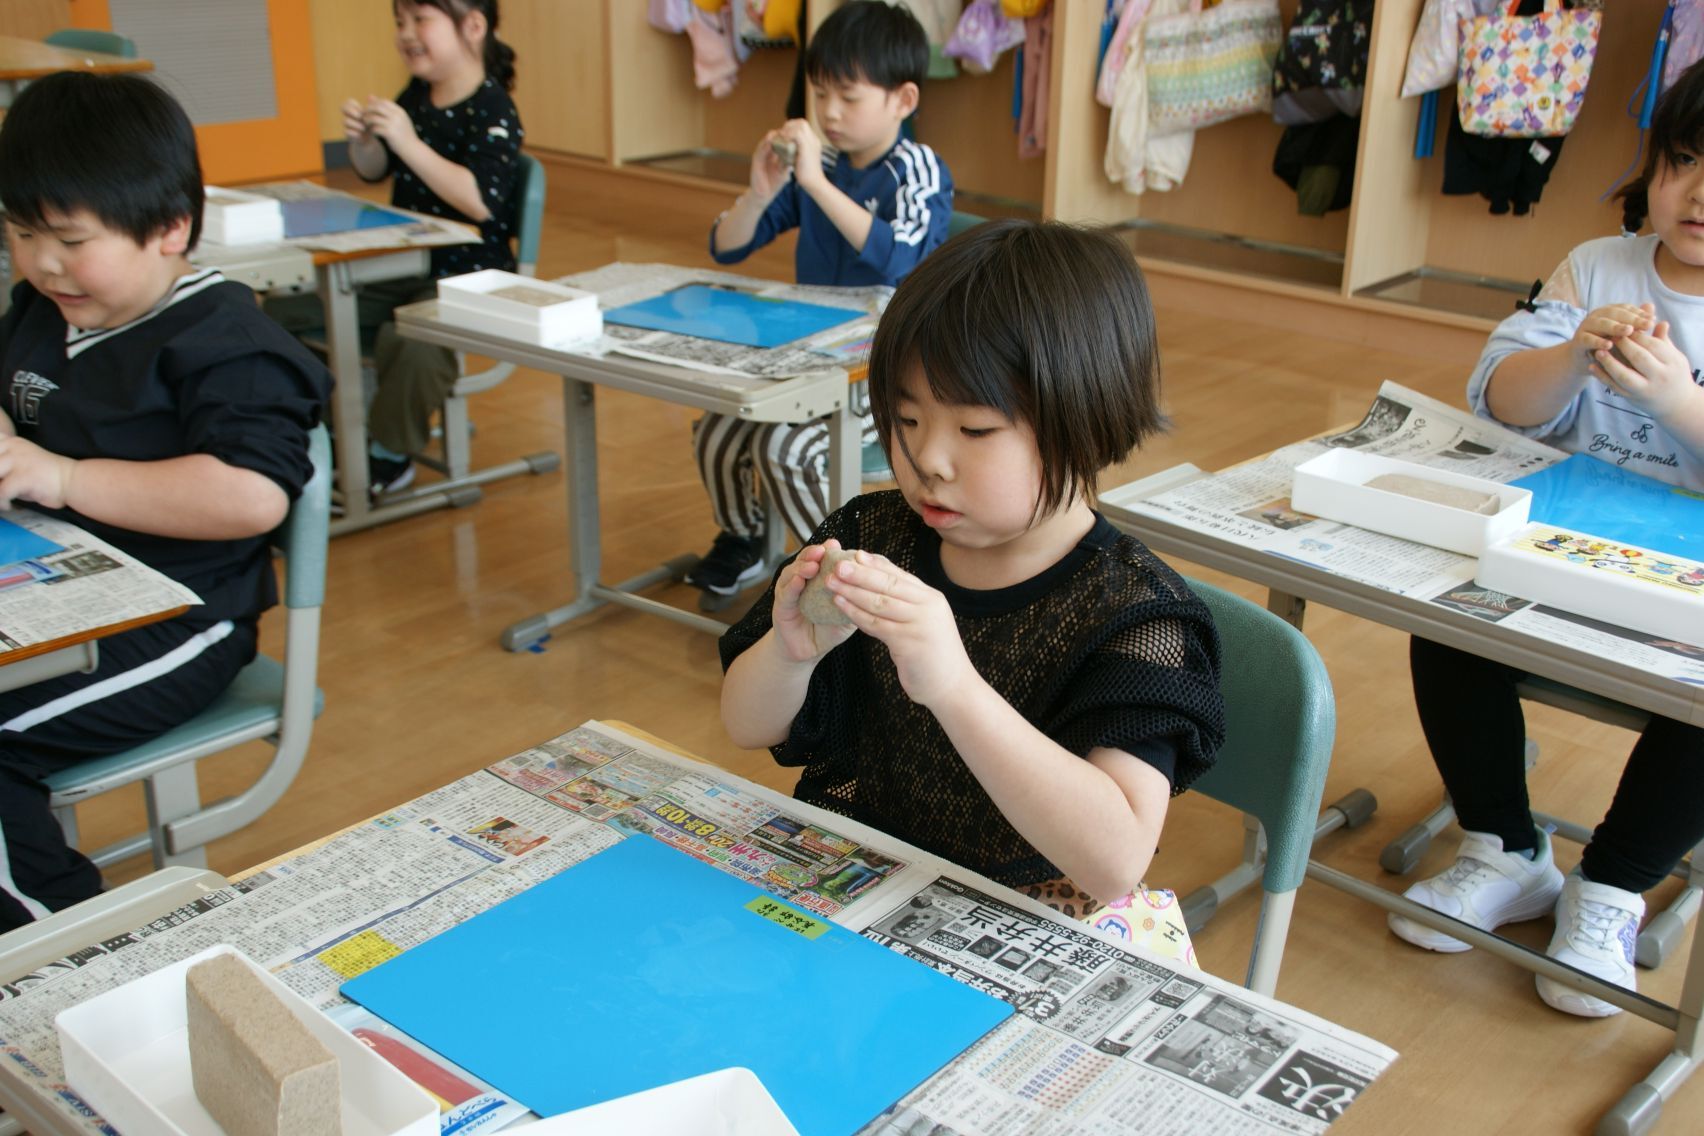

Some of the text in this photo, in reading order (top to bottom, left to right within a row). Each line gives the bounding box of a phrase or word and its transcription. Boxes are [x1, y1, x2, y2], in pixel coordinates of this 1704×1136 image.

[1588, 433, 1680, 468] Bring a smile
[936, 878, 966, 892] Gakken
[958, 903, 1112, 976] 藤井弁当
[1036, 918, 1127, 959] 0120-92-5555
[1279, 1066, 1356, 1120] 決
